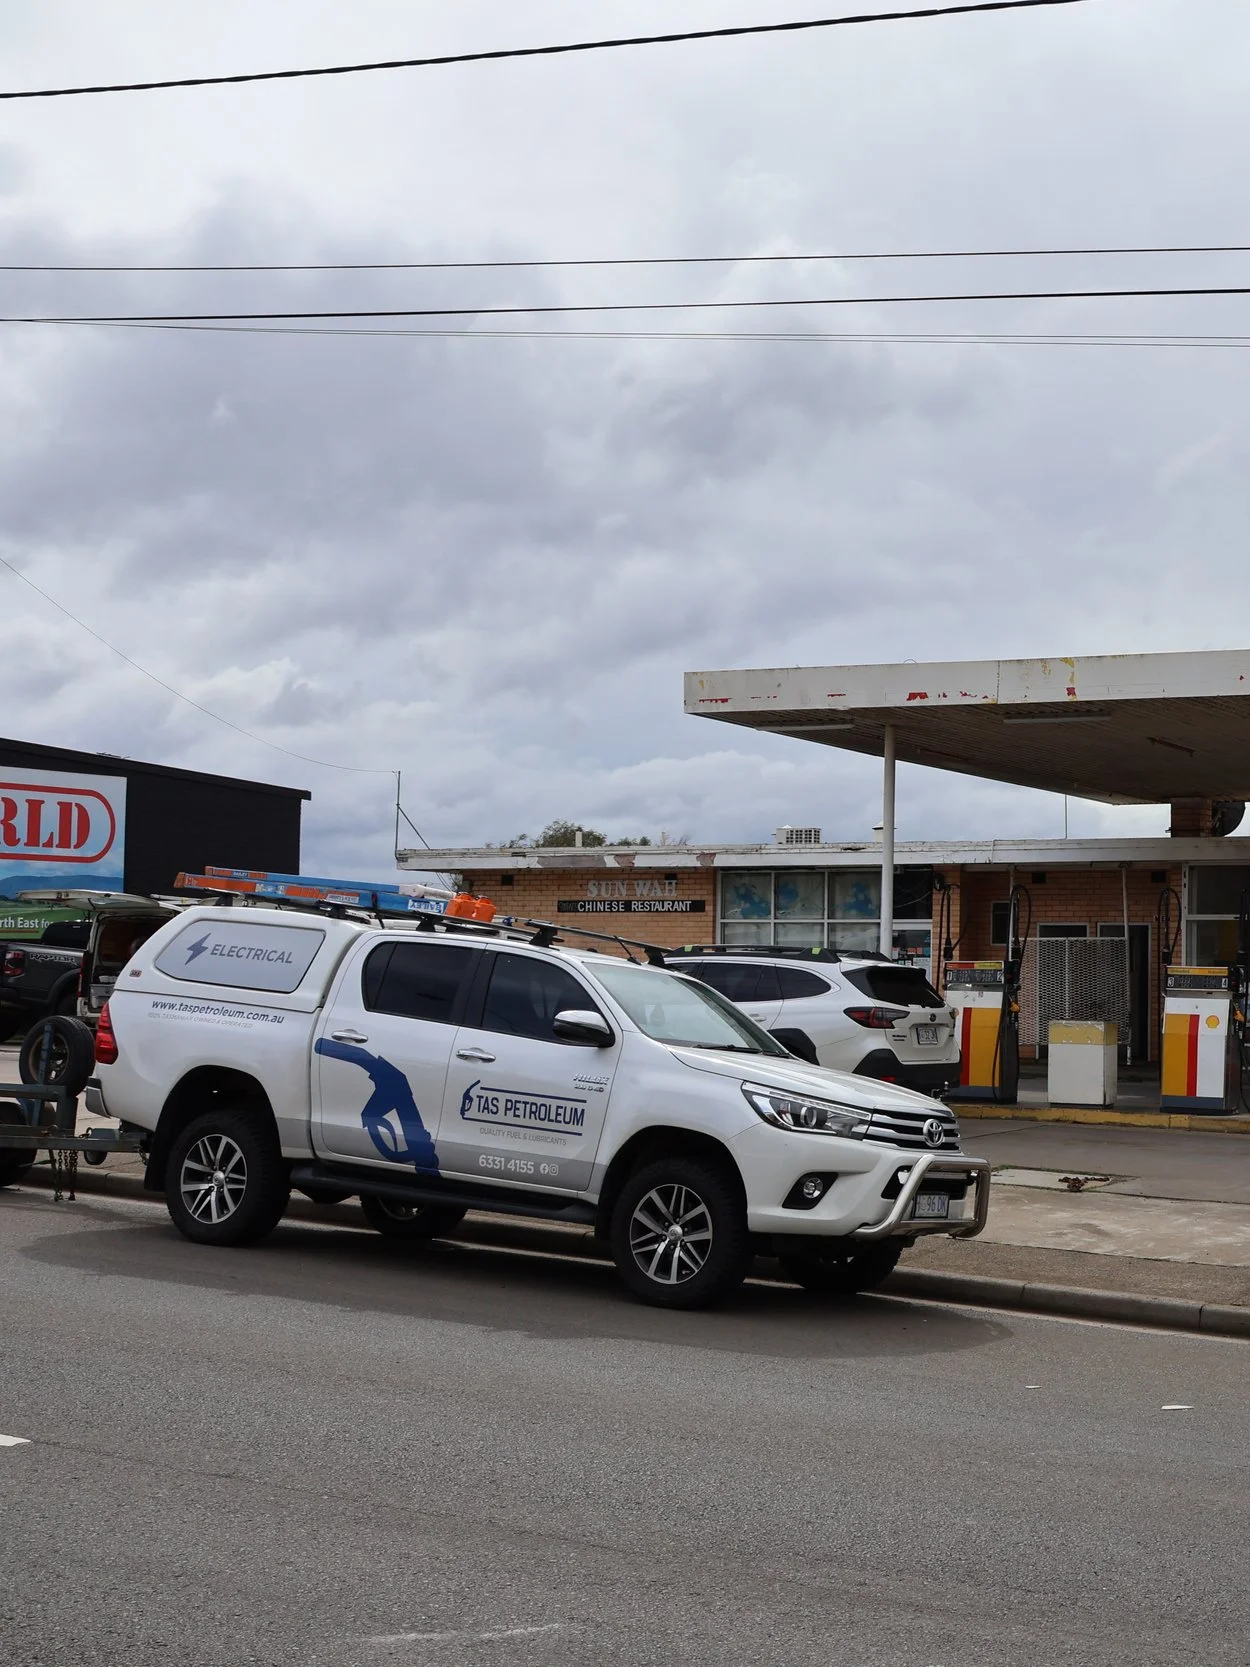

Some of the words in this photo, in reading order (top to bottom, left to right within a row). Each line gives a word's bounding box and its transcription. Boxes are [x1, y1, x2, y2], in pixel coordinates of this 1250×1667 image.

[587, 880, 628, 897] SUN
[632, 880, 678, 897] WAH
[577, 901, 625, 912] CHINESE
[631, 901, 691, 912] RESTAURANT
[17, 917, 39, 929] East
[210, 944, 292, 964] ELECTRICAL
[152, 1000, 285, 1024] www.taspetroleum.com.au
[476, 1094, 499, 1115] TAS
[504, 1098, 585, 1127] PETROLEUM
[479, 1127, 505, 1137] QUALITY
[506, 1130, 522, 1140] FUEL
[528, 1133, 567, 1146] LUBRICANTS
[478, 1154, 505, 1170] 6331
[507, 1158, 535, 1174] 4155
